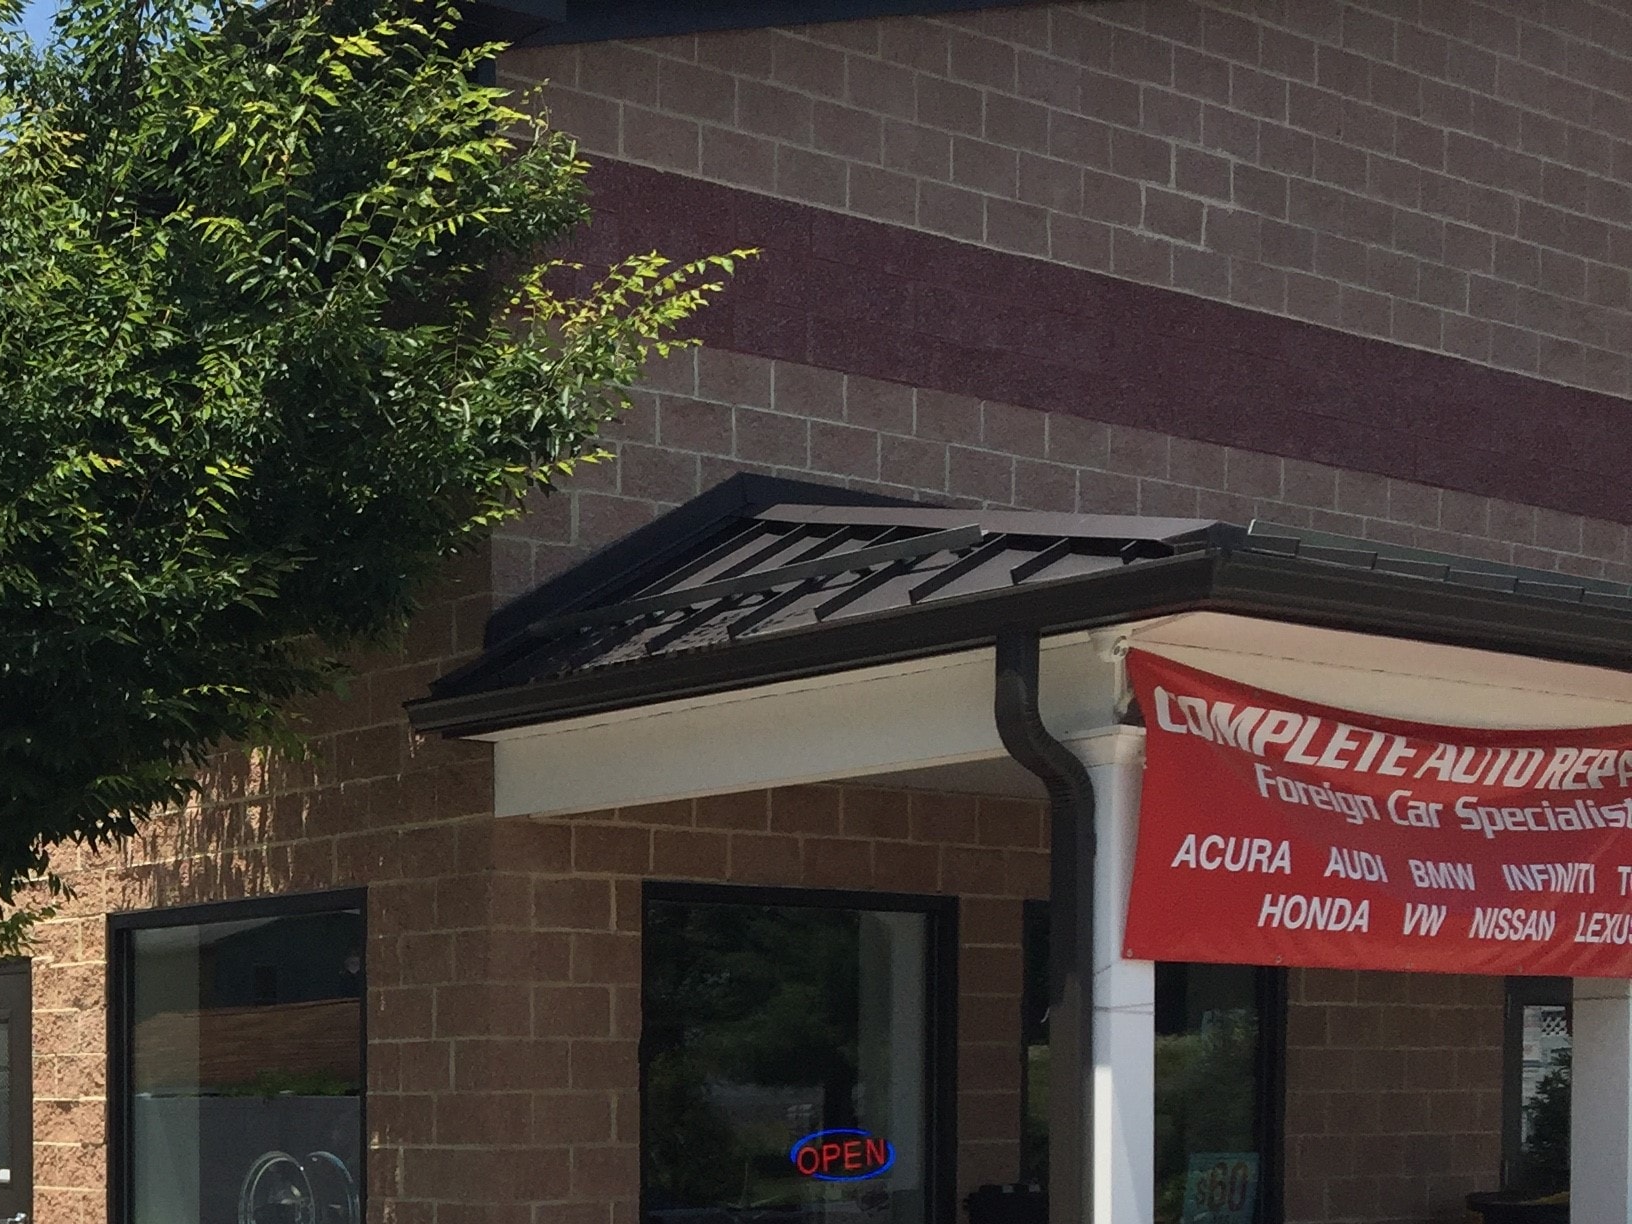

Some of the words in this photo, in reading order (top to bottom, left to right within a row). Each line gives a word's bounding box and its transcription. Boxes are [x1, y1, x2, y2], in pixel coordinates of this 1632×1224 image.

[1154, 685, 1417, 776] COMPLETE
[1414, 743, 1544, 788] AUTO
[1254, 762, 1380, 825] Foreign
[1387, 790, 1443, 828] Car
[1171, 834, 1291, 874] ACURA
[1324, 847, 1389, 882] AUDI
[1408, 858, 1476, 891] BMW
[1502, 862, 1595, 894] INFINITI
[1257, 894, 1371, 933] HONDA
[1402, 903, 1447, 937] VW
[1469, 907, 1556, 942] NISSAN
[1574, 912, 1632, 945] LEXU
[797, 1138, 886, 1175] OPEN
